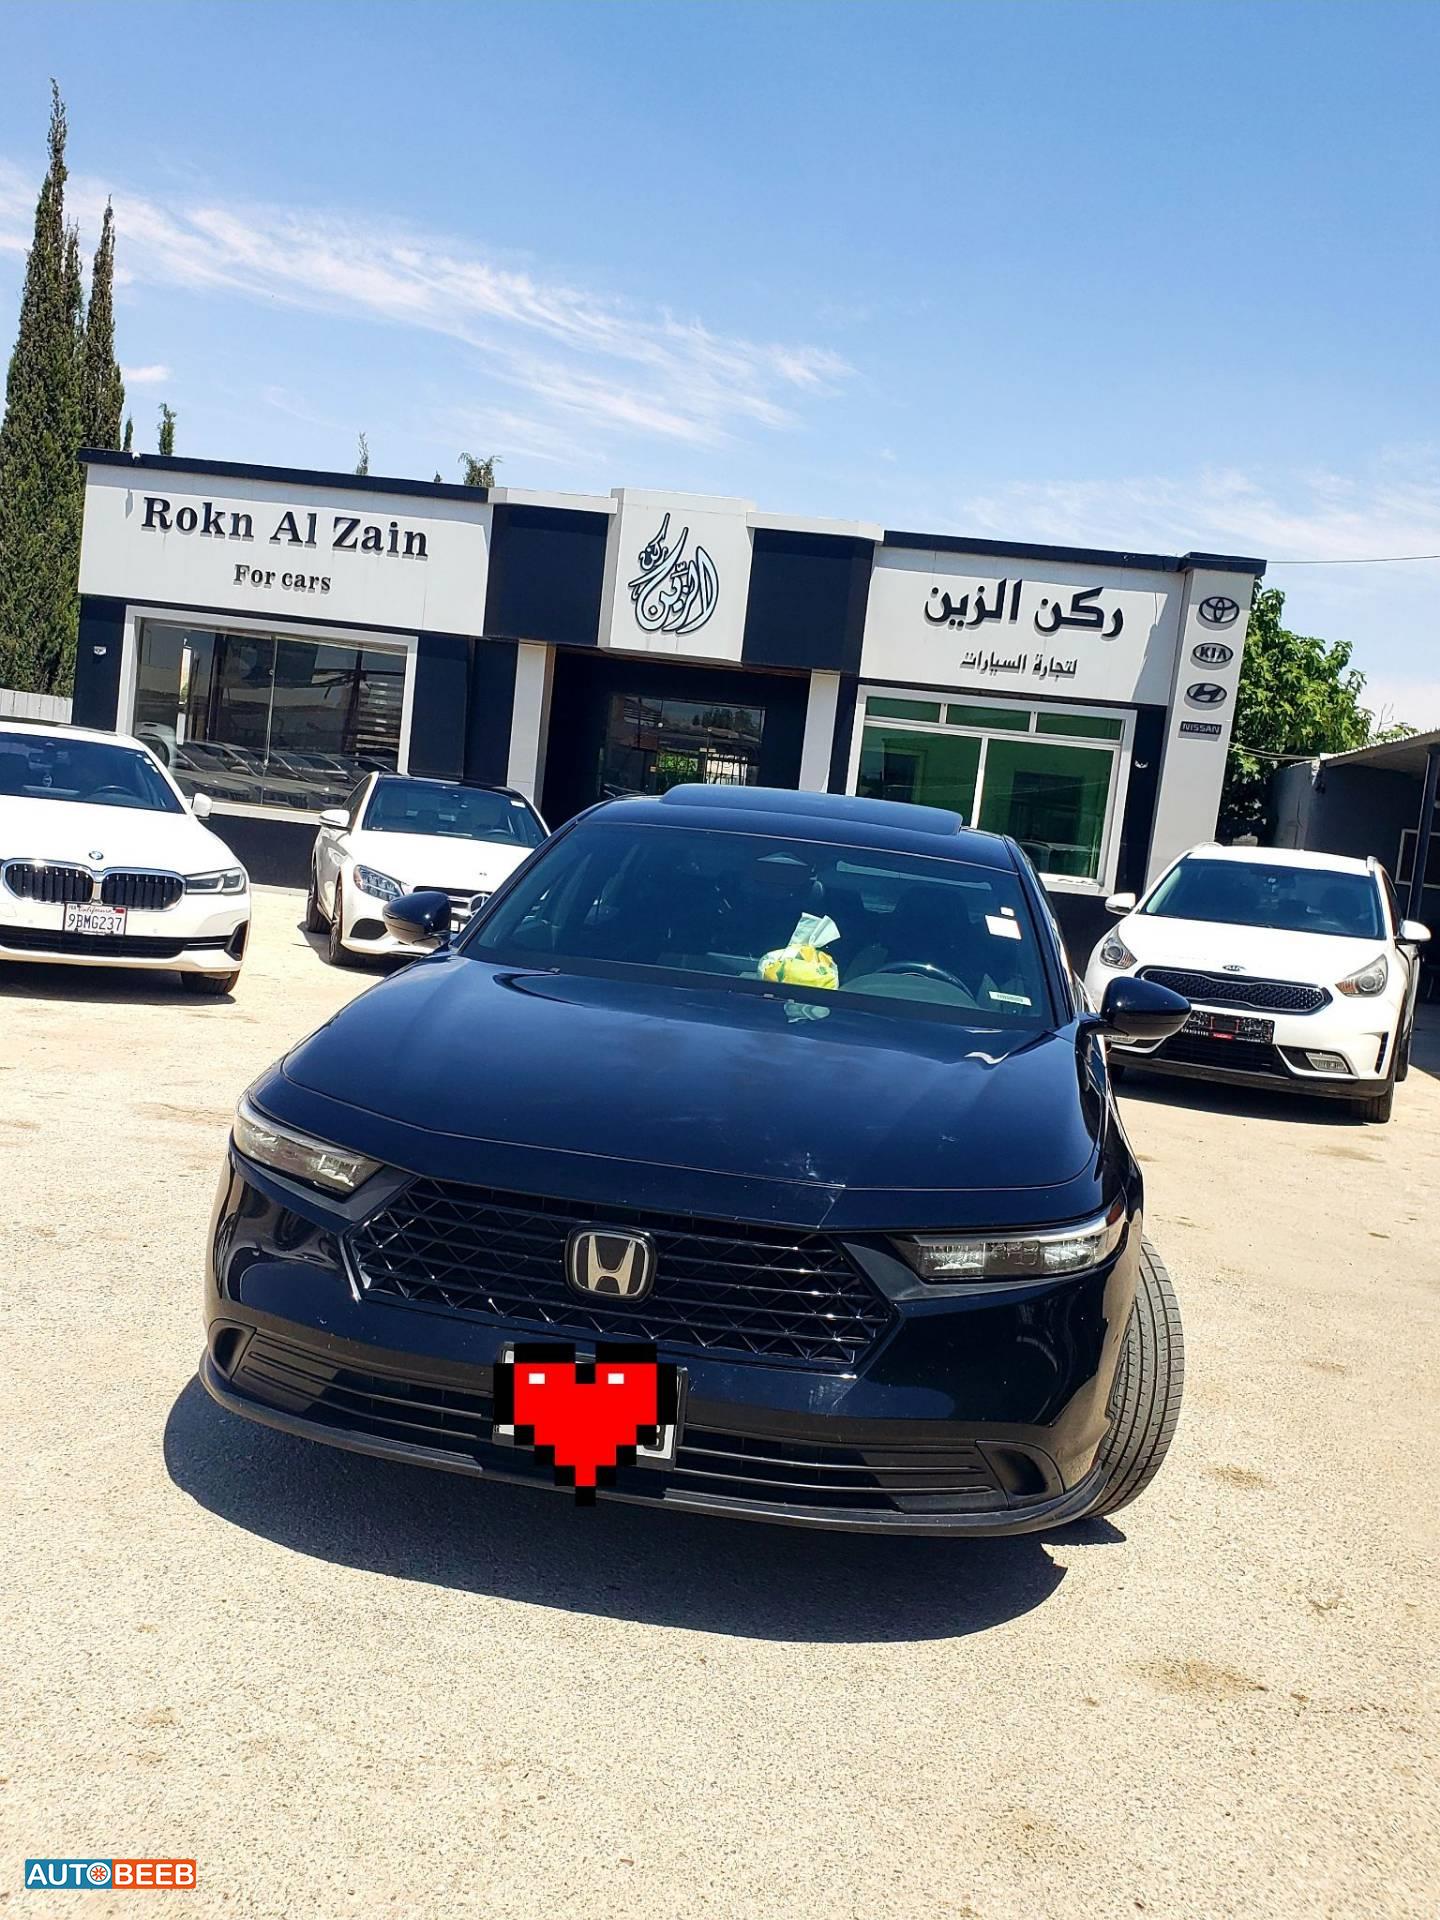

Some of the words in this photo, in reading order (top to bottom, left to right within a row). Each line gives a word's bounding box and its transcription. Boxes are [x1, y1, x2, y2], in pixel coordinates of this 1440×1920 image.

[142, 497, 254, 539] Rokn
[270, 511, 317, 546] Al
[333, 516, 428, 558] Zain
[234, 564, 276, 587] For
[281, 573, 331, 593] cars
[924, 578, 1023, 627] الزين
[1034, 586, 1124, 638] ركن
[961, 650, 1027, 673] السيارات
[1033, 653, 1078, 679] لتجارة
[1198, 646, 1227, 660] KIA
[1182, 722, 1221, 734] NISSAN
[68, 913, 122, 931] 9BMG237
